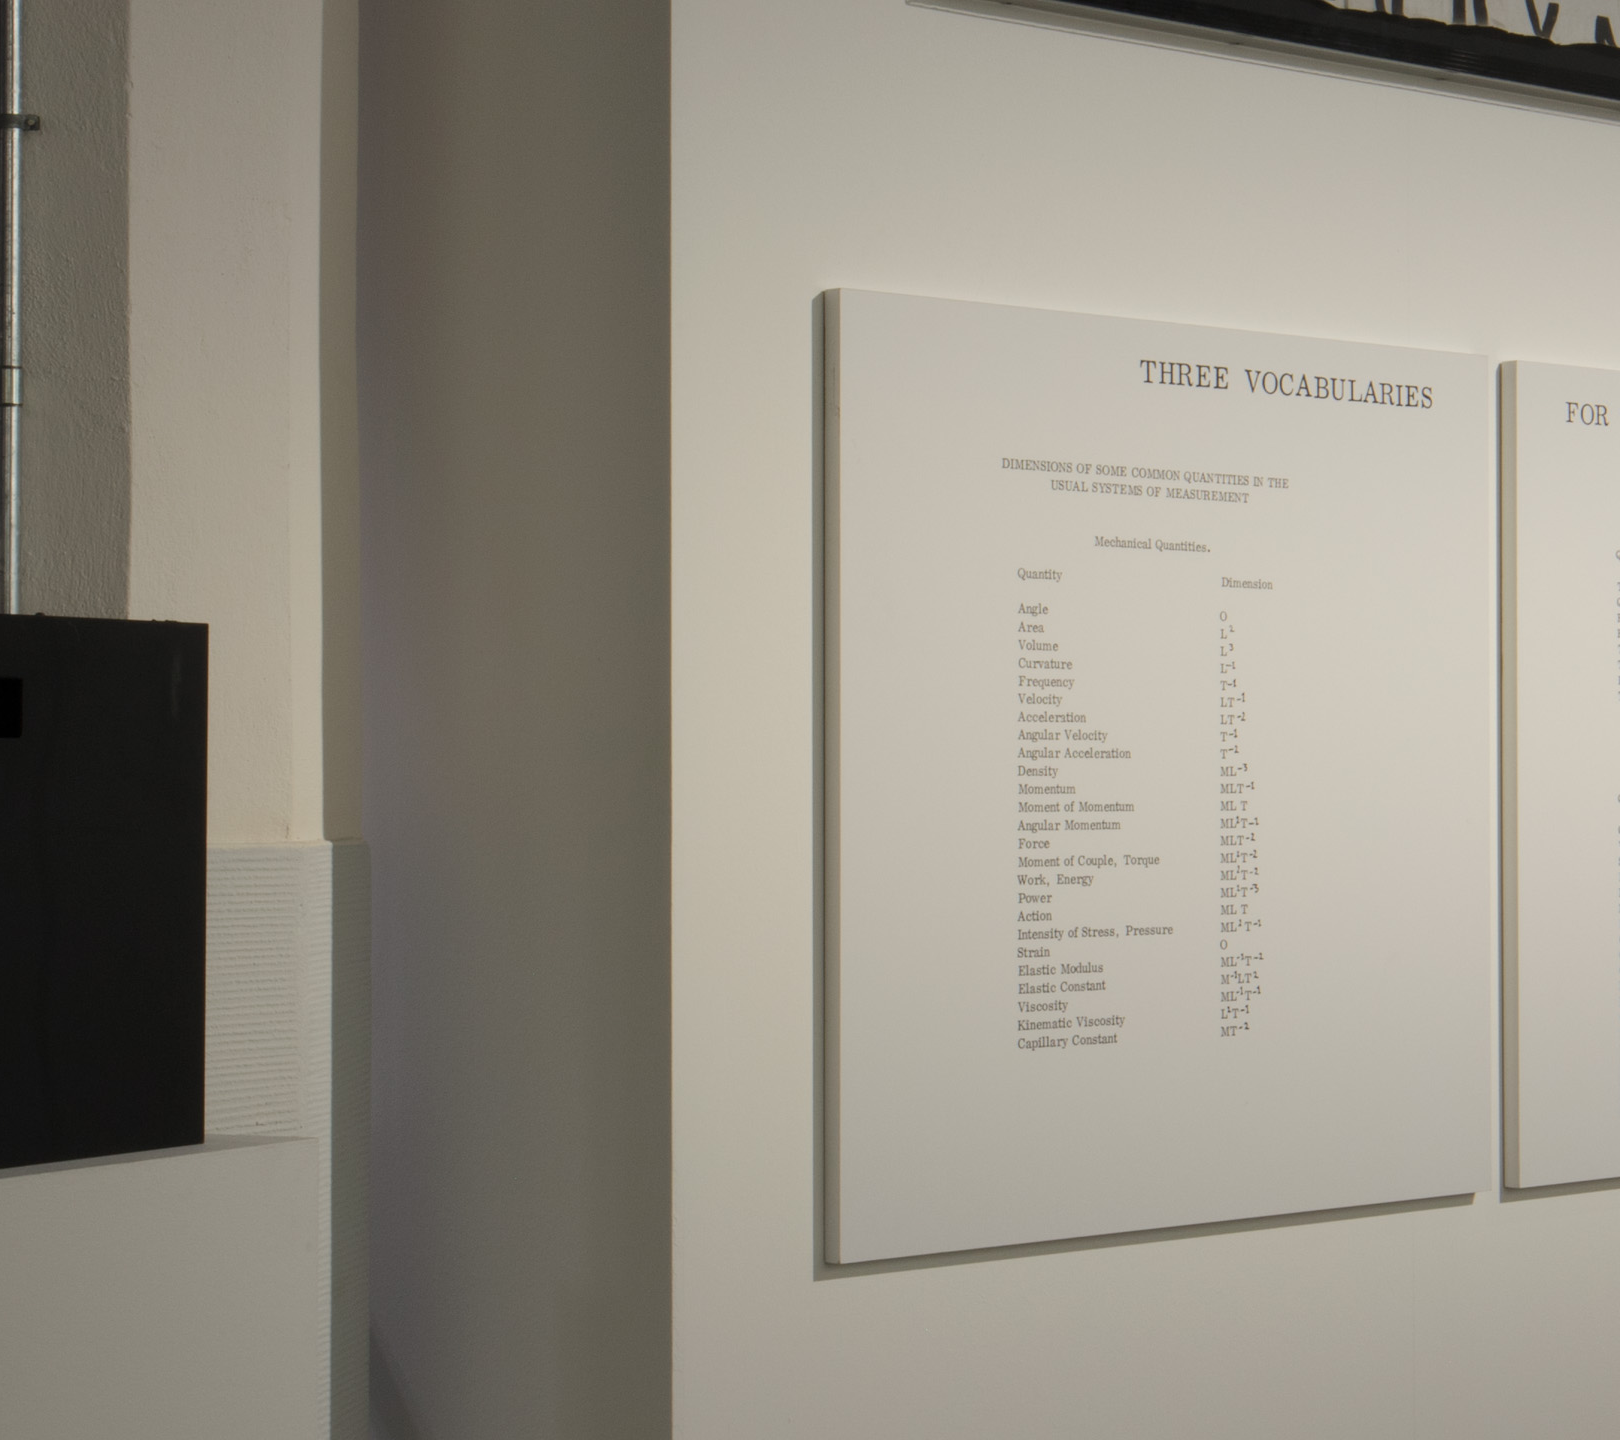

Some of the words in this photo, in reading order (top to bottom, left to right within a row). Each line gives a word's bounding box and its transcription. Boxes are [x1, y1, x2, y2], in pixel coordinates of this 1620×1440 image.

[1140, 359, 1229, 390] THREE
[1245, 369, 1433, 410] VOCABULARIES
[1566, 402, 1609, 426] FOR
[1002, 458, 1073, 473] DIMENSIONS
[1076, 463, 1092, 475] OF
[1096, 465, 1127, 477] SOME
[1132, 467, 1180, 480] COMMON
[1184, 471, 1249, 486] QUANTITIES
[1254, 476, 1264, 487] IN
[1267, 477, 1289, 489] THE
[1051, 480, 1088, 493] USUAL
[1092, 482, 1142, 496] SYSTEMS
[1147, 486, 1161, 497] OF
[1166, 488, 1249, 503] MEASUREMENT
[1094, 536, 1151, 550] Mechanical
[1155, 539, 1211, 553] Quantities.
[1017, 568, 1062, 582] Quantity
[1221, 577, 1273, 590] Dimension
[1018, 603, 1048, 617] Angle
[1018, 622, 1044, 633] Area
[1018, 640, 1058, 652] Volume
[1018, 658, 1072, 670] Curvature
[1018, 676, 1074, 690] Frequency
[1018, 693, 1062, 707] Velocity
[1018, 711, 1086, 723] Acceleration
[1018, 729, 1060, 743] Angular
[1065, 729, 1108, 743] Velocity
[1018, 748, 1060, 761] Angular
[1064, 748, 1131, 759] Acceleration
[1018, 766, 1058, 778] Density
[1018, 784, 1076, 794] Momentum
[1018, 802, 1060, 813] Moment
[1064, 802, 1075, 813] of
[1079, 802, 1134, 812] Momentum
[1018, 820, 1060, 834] Angular
[1065, 820, 1120, 830] Momentum
[1018, 839, 1050, 849] Force
[1018, 857, 1060, 868] Moment
[1064, 856, 1074, 866] of
[1078, 856, 1117, 869] Couple,
[1124, 855, 1159, 867] Torque
[1018, 875, 1050, 887] Work,
[1056, 874, 1094, 888] Energy
[1018, 893, 1052, 904] Power
[1018, 911, 1052, 922] Action
[1018, 928, 1064, 942] Intensity
[1068, 927, 1078, 938] of
[1082, 926, 1119, 939] Stress,
[1126, 925, 1173, 936] Pressure
[1017, 947, 1050, 958] Strain
[1018, 965, 1056, 976] Elastic
[1061, 963, 1103, 974] Modulus
[1018, 983, 1056, 994] Elastic
[1060, 981, 1106, 992] Constant
[1018, 1000, 1068, 1014] Viscosity
[1018, 1018, 1072, 1031] Kinematic
[1076, 1015, 1125, 1029] Viscosity
[1018, 1036, 1068, 1051] Capillary
[1072, 1034, 1117, 1046] Constant
